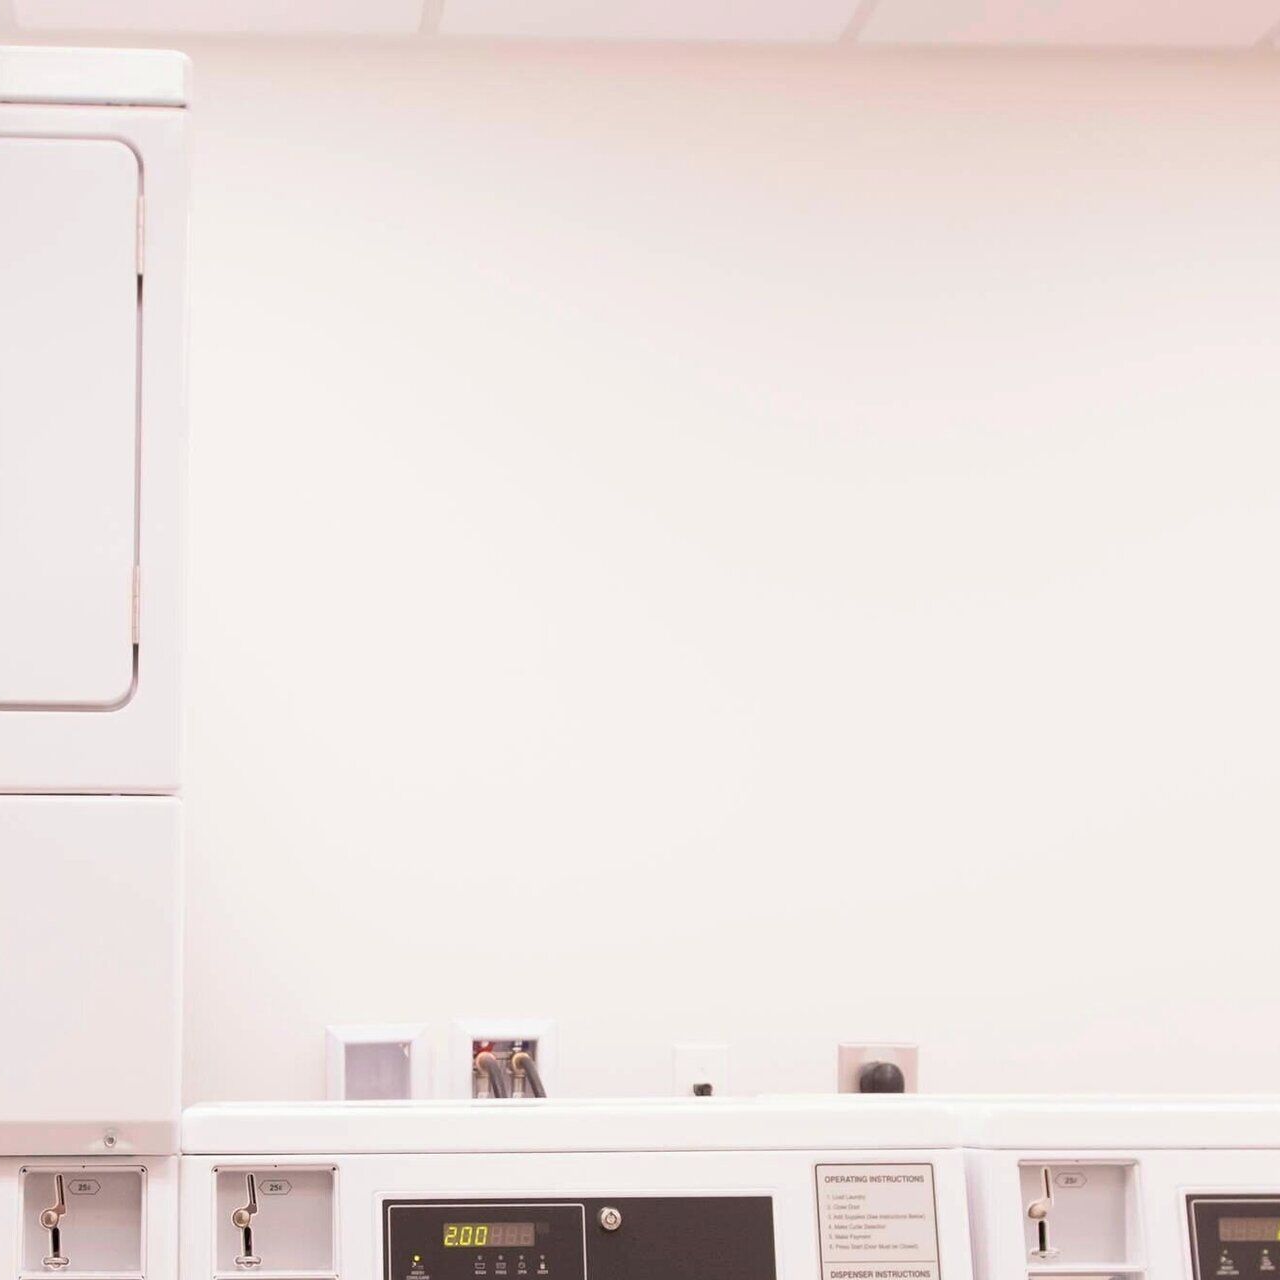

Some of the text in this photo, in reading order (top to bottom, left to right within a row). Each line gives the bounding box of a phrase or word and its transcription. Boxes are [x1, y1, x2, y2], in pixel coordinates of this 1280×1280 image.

[824, 1175, 925, 1183] OPERATING INSTRUCTIONS
[444, 1226, 489, 1246] 2.00
[830, 1270, 931, 1278] DISPENSER INSTRUCTIONS
